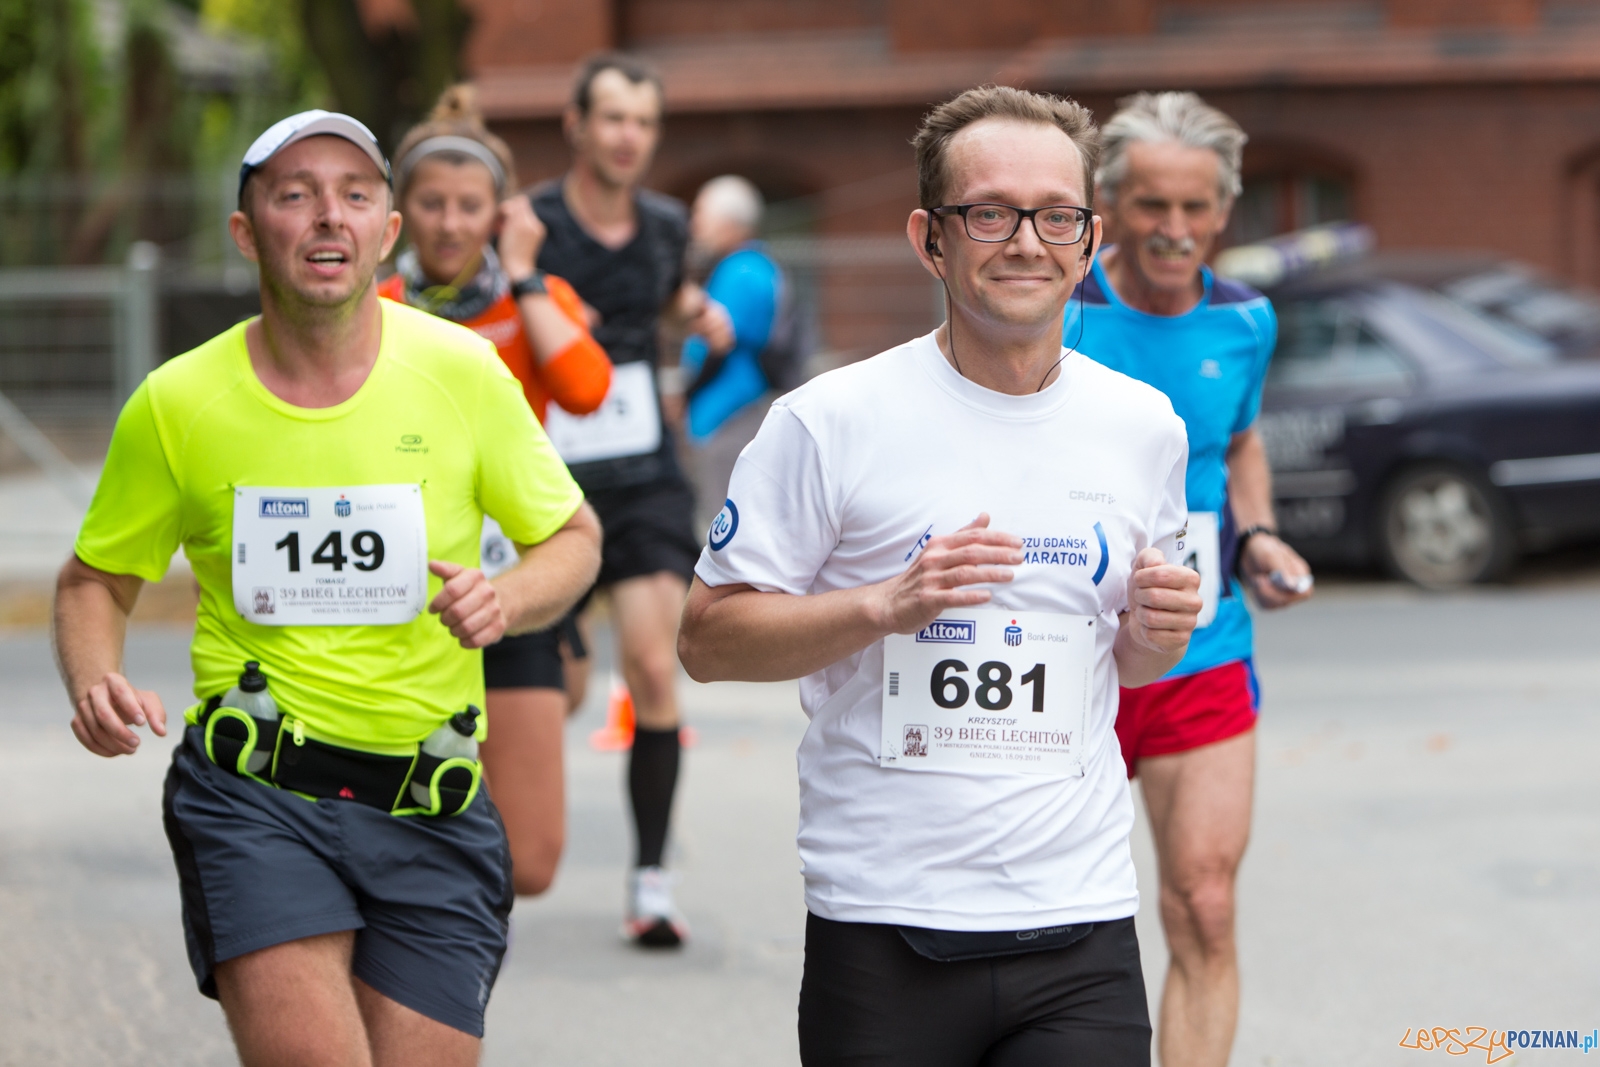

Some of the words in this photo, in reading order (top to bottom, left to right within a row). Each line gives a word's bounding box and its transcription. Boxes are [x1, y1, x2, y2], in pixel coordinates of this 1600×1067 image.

[1069, 490, 1107, 503] CRAFT
[1043, 535, 1088, 549] GDAŃSK
[274, 529, 386, 573] 149
[279, 587, 297, 600] 39
[300, 586, 335, 600] BIEG
[338, 584, 409, 598] LECHITÓW
[1027, 632, 1046, 642] Bank
[1047, 633, 1069, 644] Polski
[930, 658, 1046, 713] 681
[967, 717, 1018, 726] KRZYSZTOF
[934, 726, 953, 741] 39
[958, 727, 996, 742] BIEG
[1001, 729, 1073, 745] LECHITÓW
